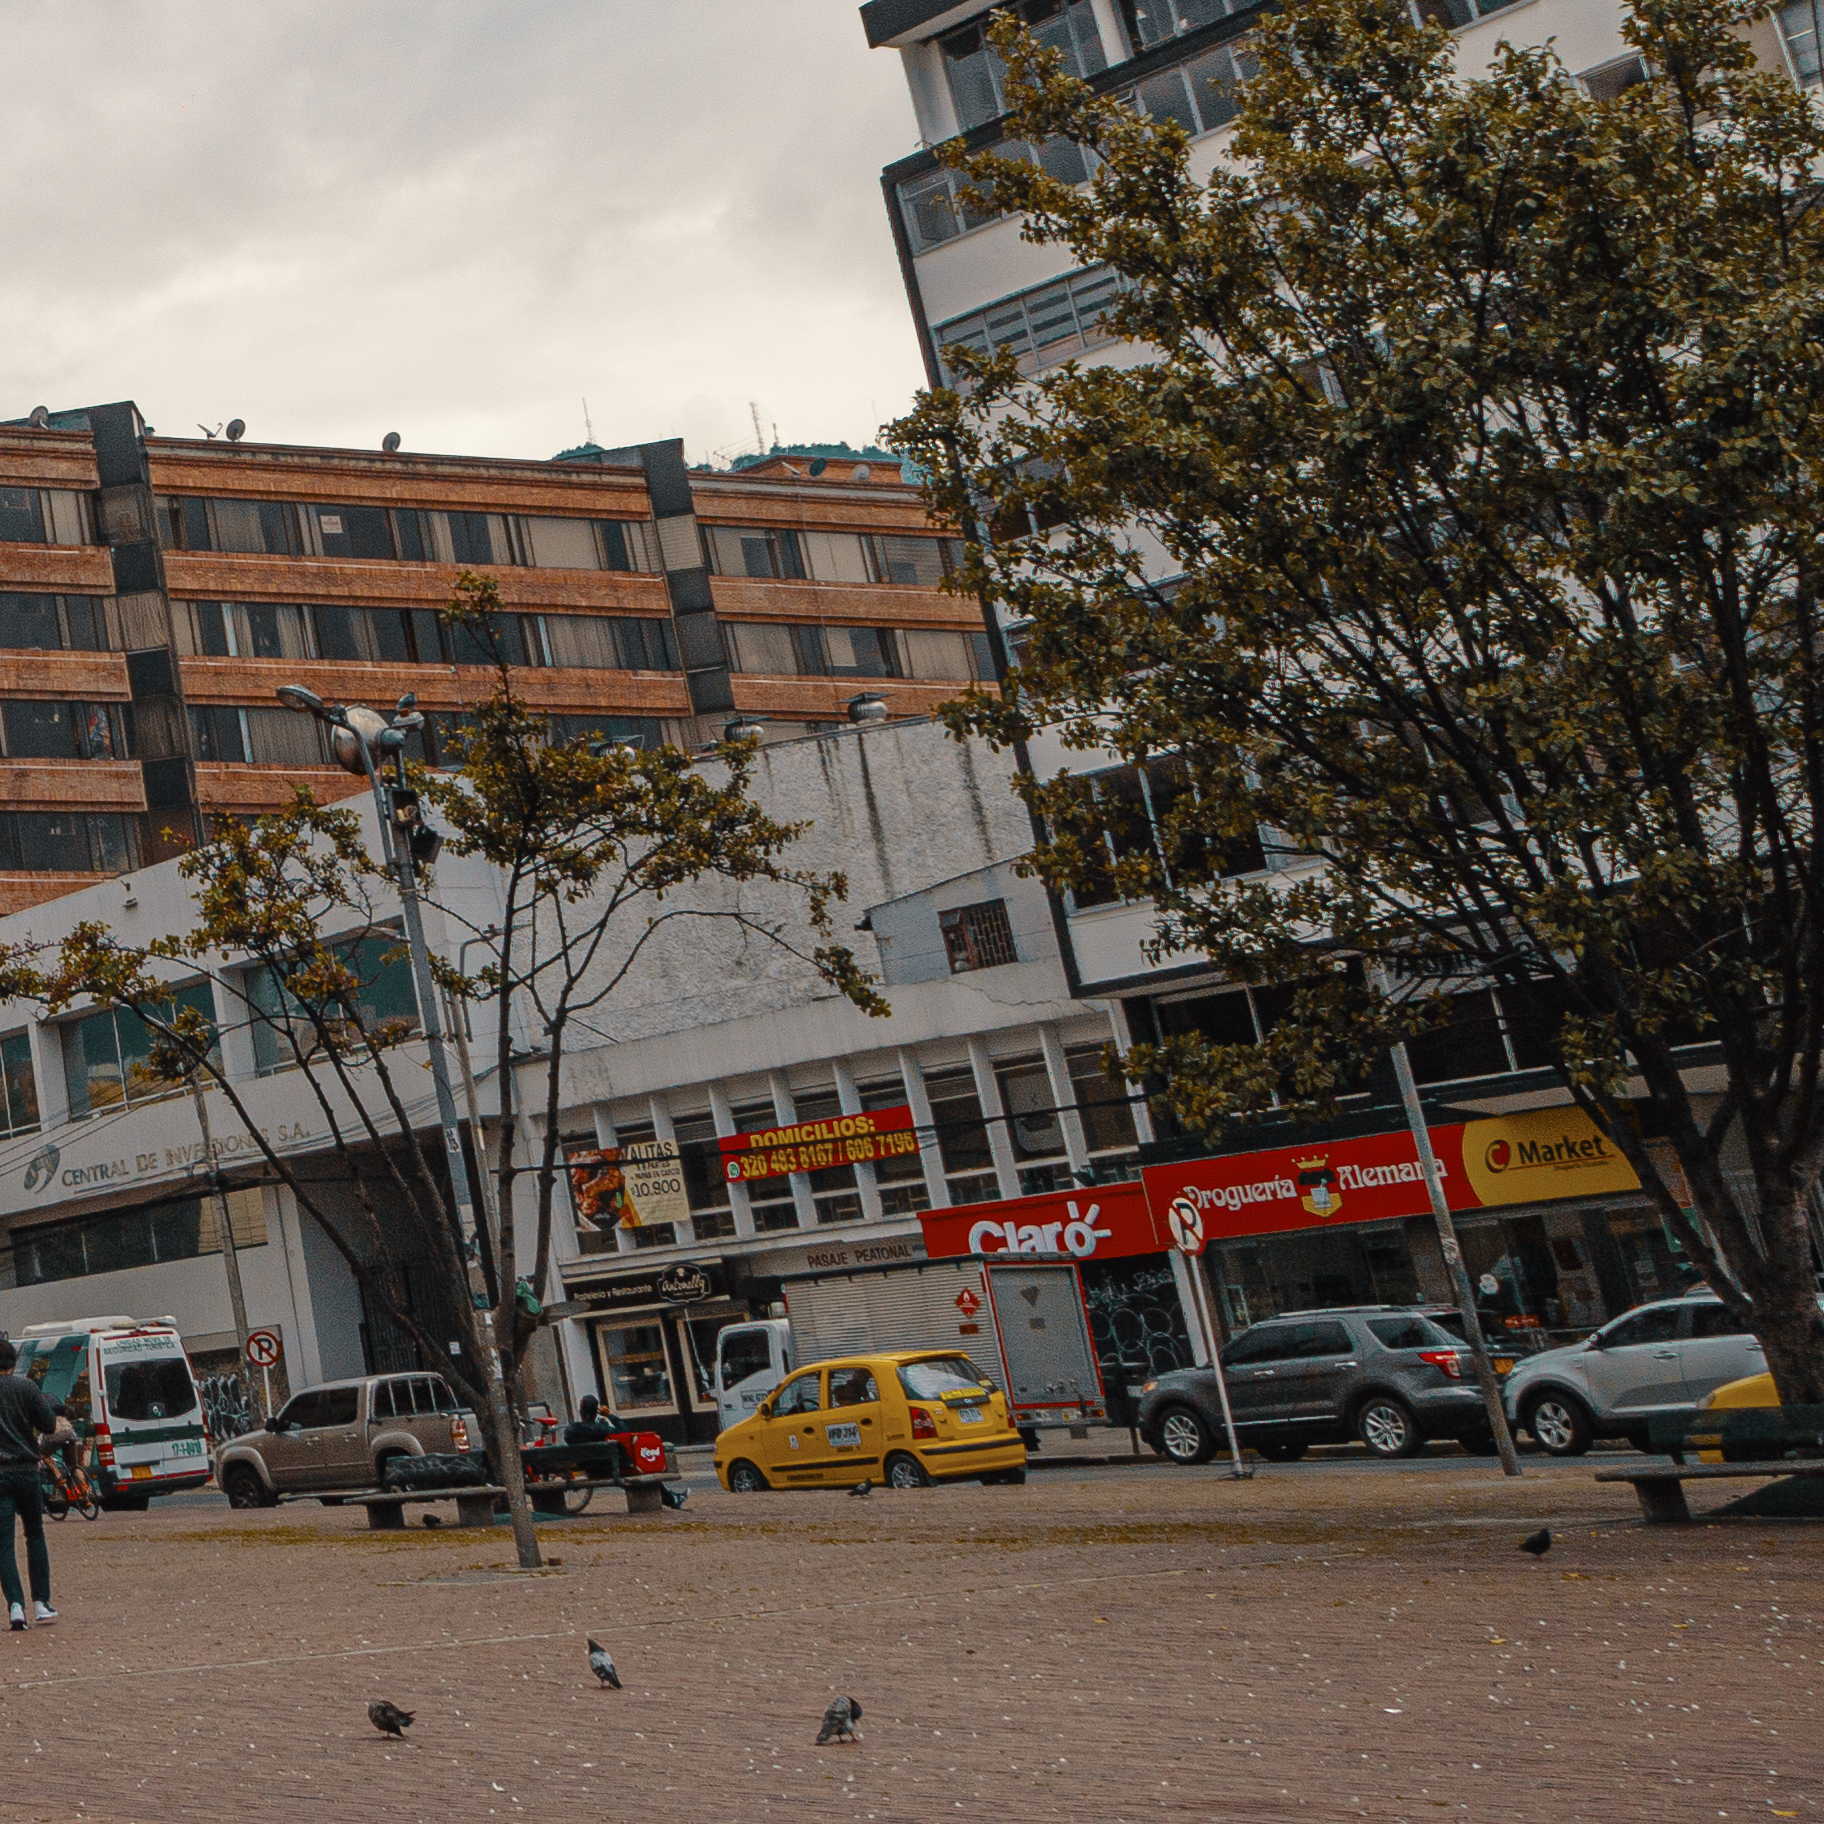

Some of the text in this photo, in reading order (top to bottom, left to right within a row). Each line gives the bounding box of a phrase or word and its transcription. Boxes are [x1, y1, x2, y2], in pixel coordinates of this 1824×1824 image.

[749, 1116, 876, 1148] DOMICILIOS:
[1516, 1134, 1609, 1165] Market
[61, 1159, 130, 1188] CENTRAL
[135, 1152, 159, 1173] DE
[740, 1154, 768, 1179] 320
[807, 1243, 912, 1270] PASAJE PEATONAL
